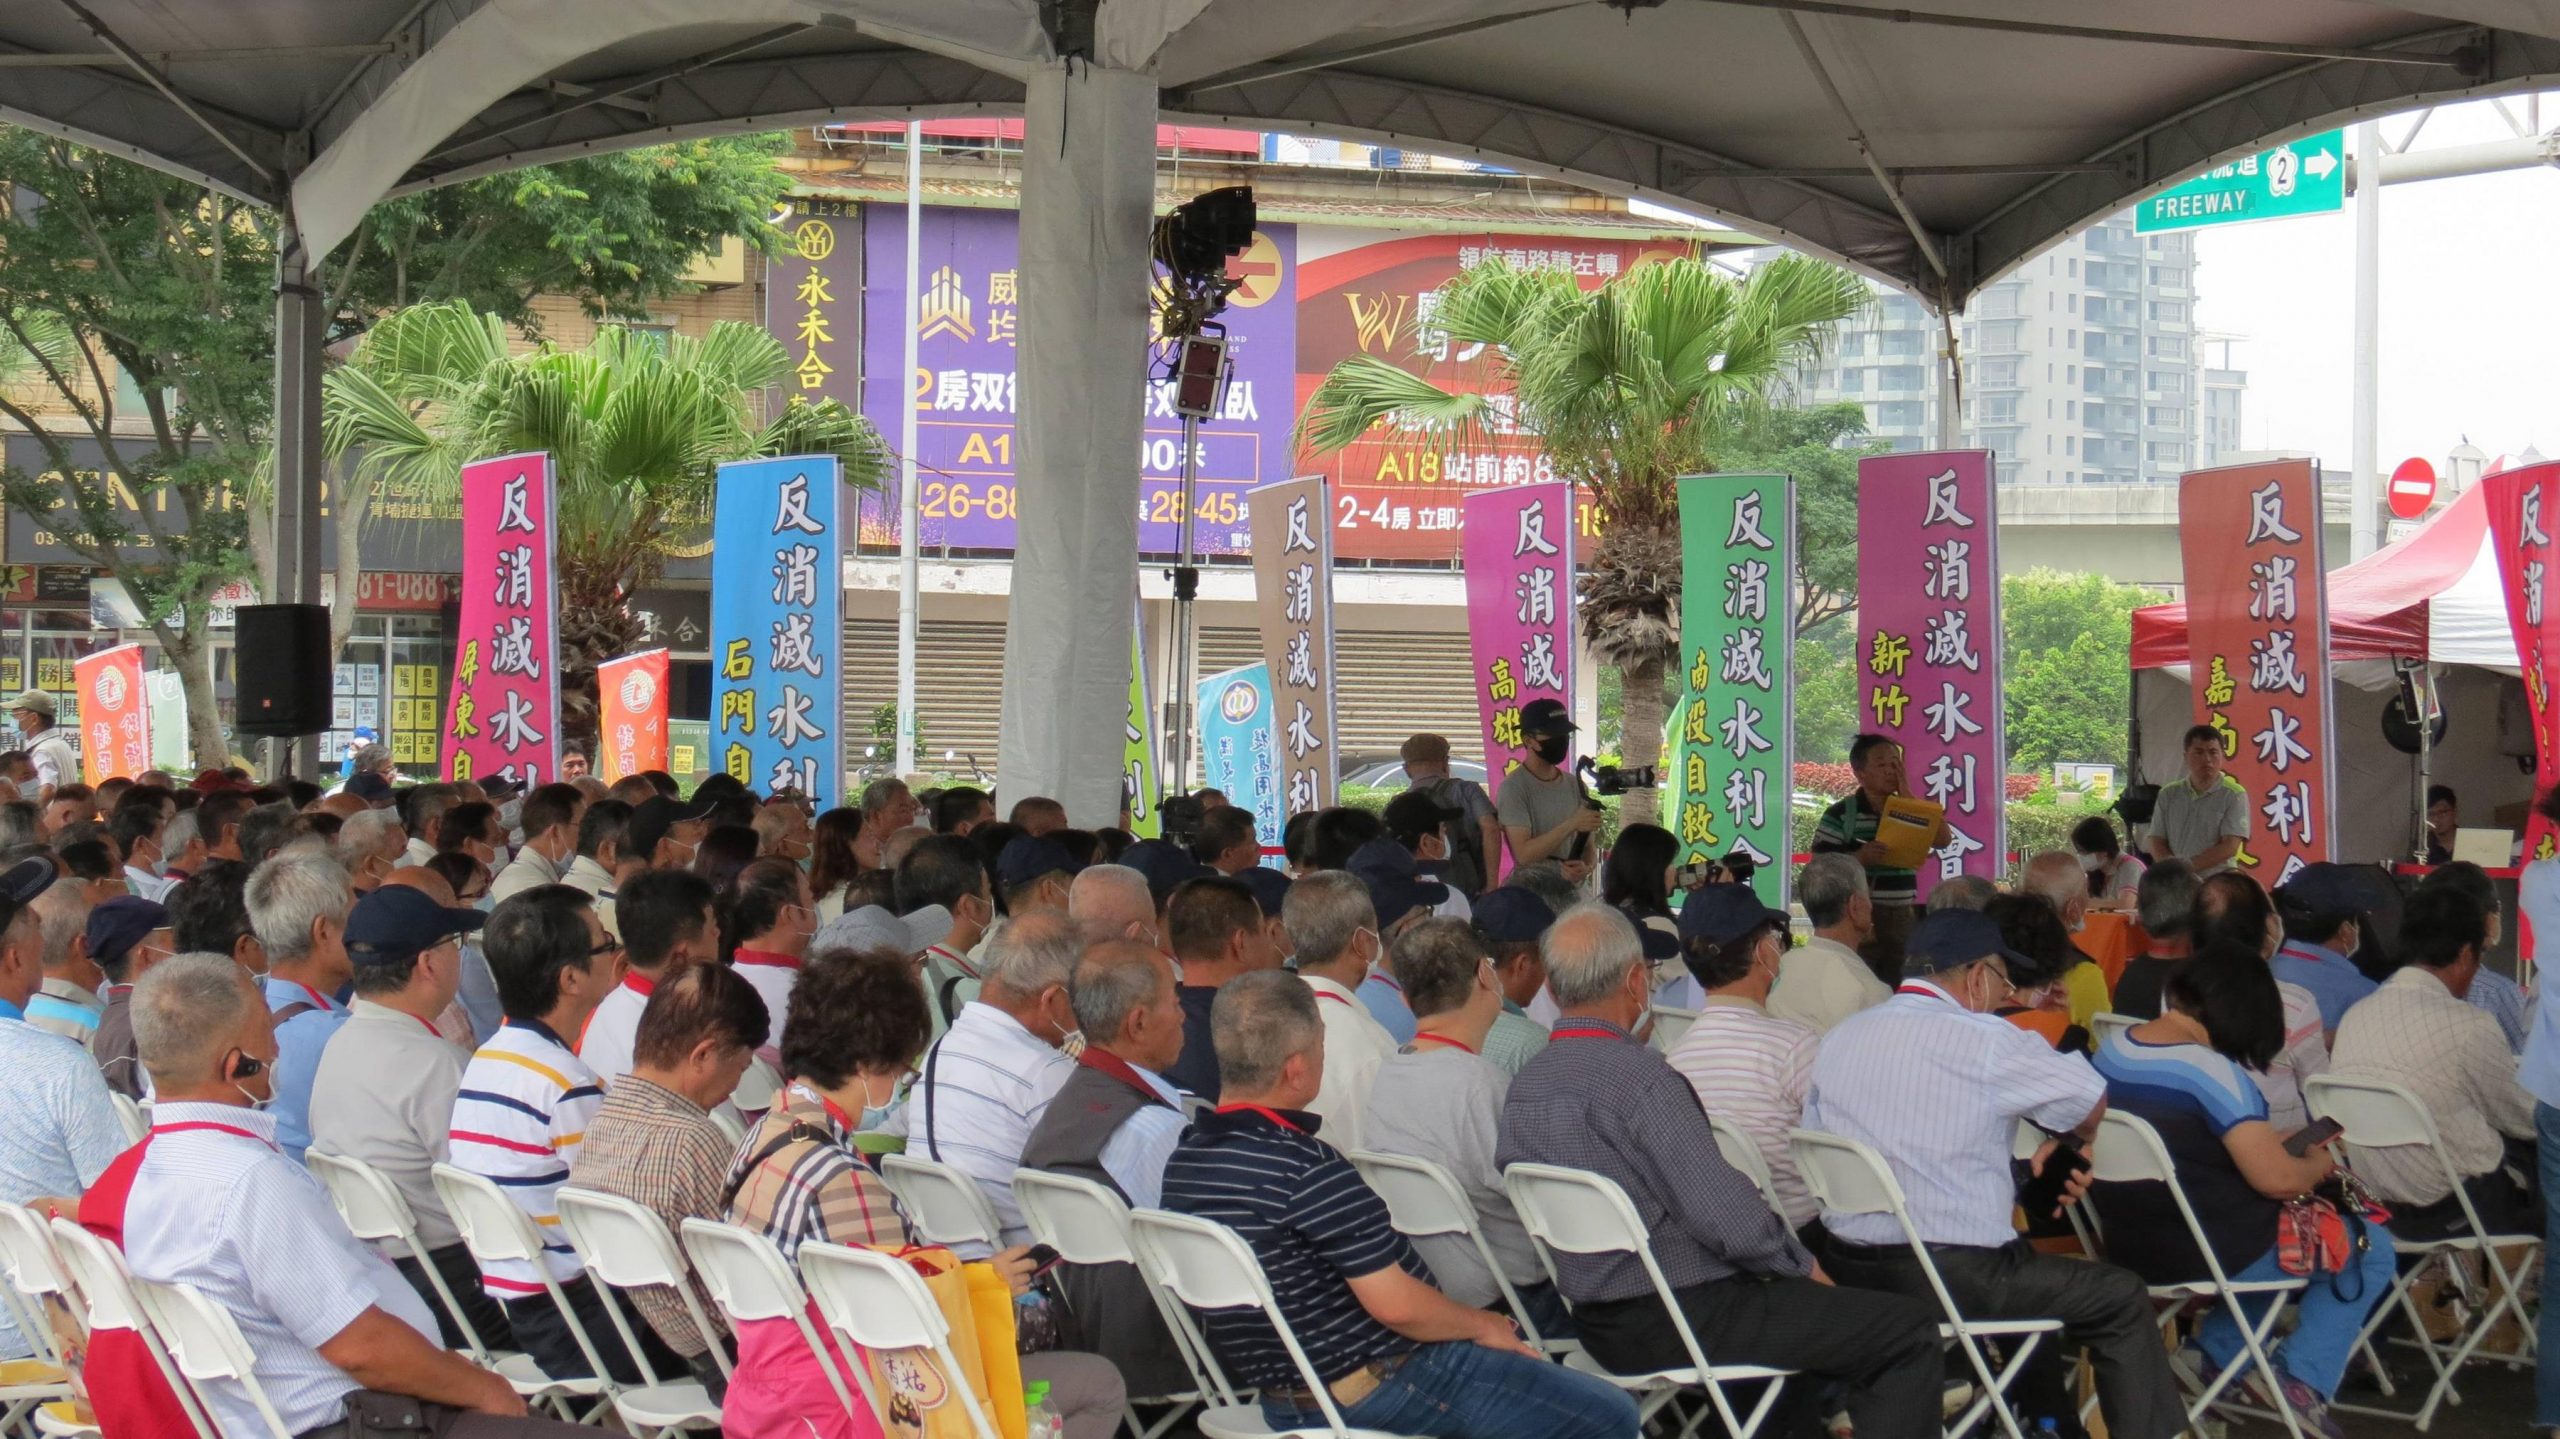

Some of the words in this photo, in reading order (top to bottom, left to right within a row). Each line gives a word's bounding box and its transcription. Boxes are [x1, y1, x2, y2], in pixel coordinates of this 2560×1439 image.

[2277, 156, 2288, 185] 2
[795, 200, 858, 218] 請上2樓
[2154, 189, 2247, 220] FREEWAY
[795, 265, 836, 390] 永禾合
[915, 367, 1017, 414] 2房双
[916, 482, 1017, 520] 26-8
[1416, 506, 1465, 531] 立即
[1513, 499, 1563, 690] 反消滅
[1284, 495, 1322, 813] 反消滅水利
[1921, 468, 1984, 879] 反消滅水利會
[721, 637, 756, 786] 石門自
